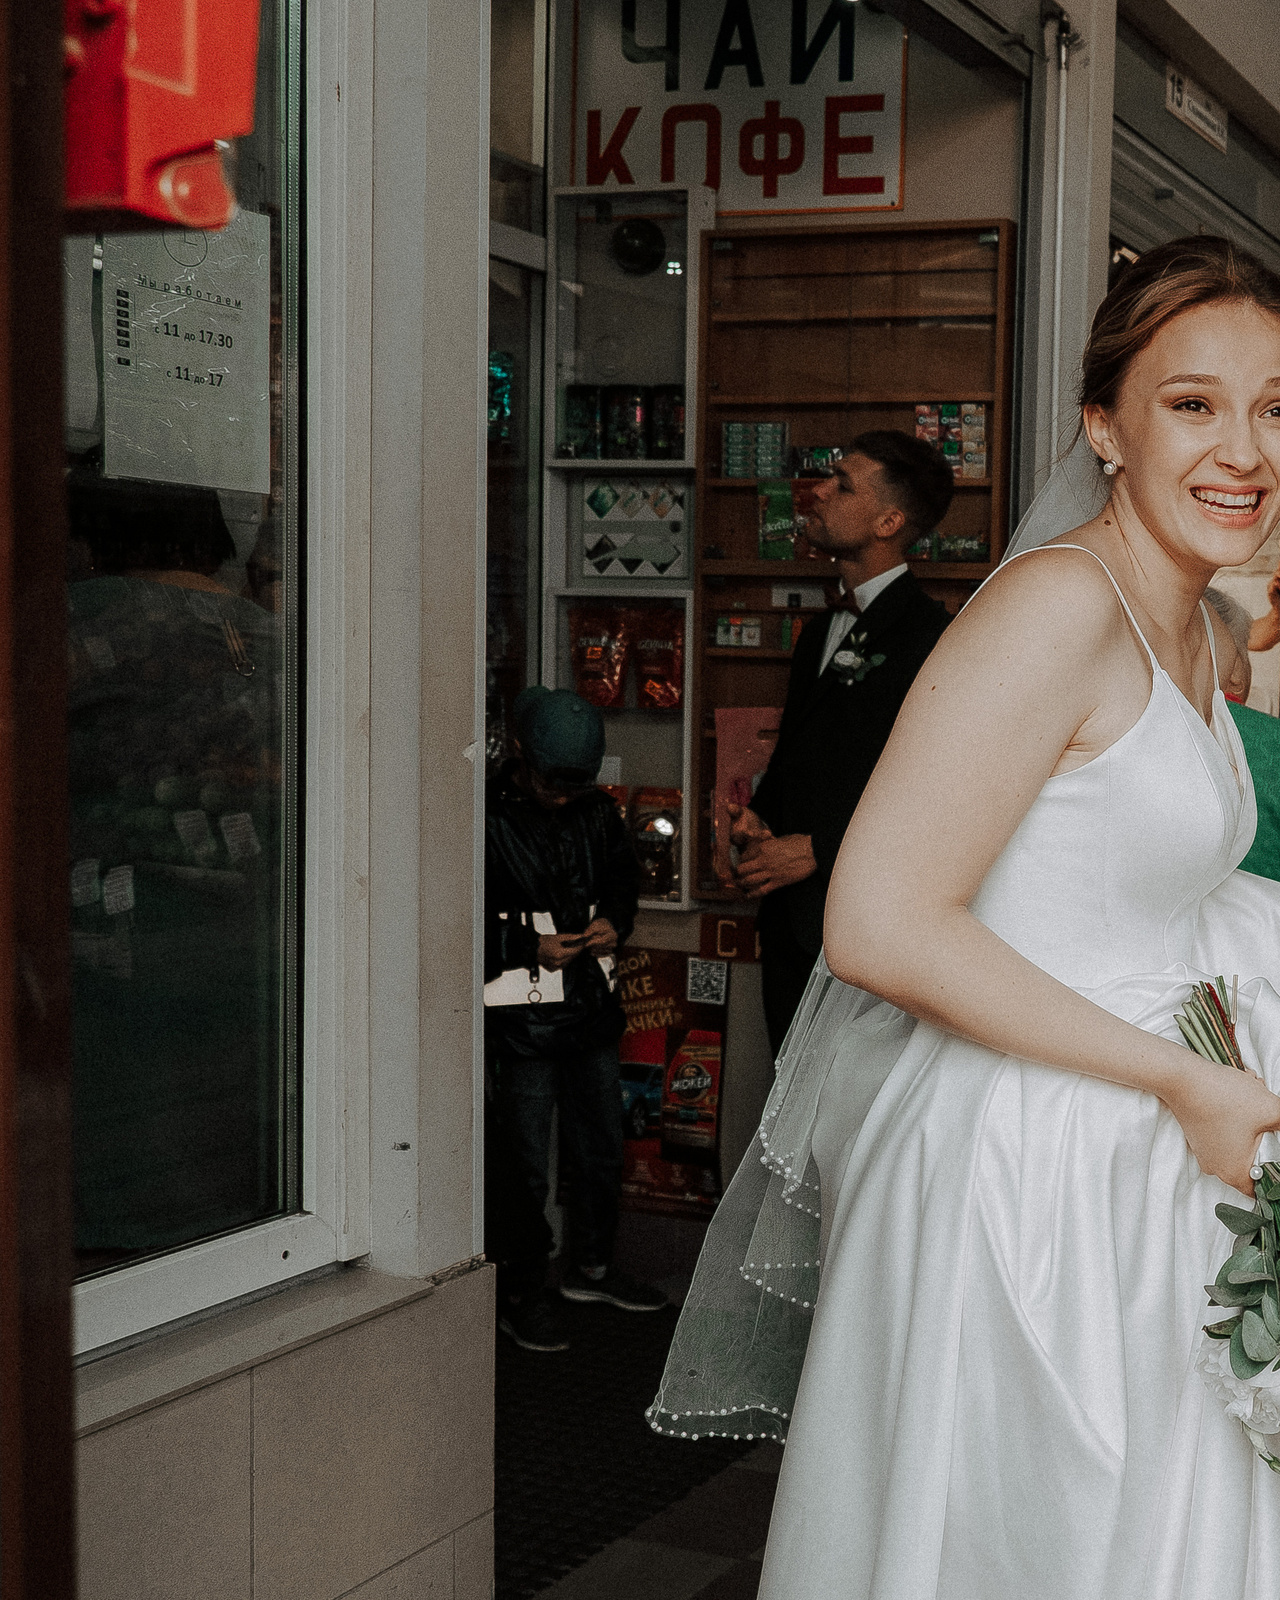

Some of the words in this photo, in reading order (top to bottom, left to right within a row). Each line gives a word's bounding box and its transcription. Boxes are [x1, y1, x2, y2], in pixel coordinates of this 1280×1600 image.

[586, 94, 885, 198] КОФЕ
[164, 281, 242, 308] работаем
[164, 322, 180, 337] 11
[184, 333, 196, 342] до
[199, 330, 233, 349] 17.30
[175, 366, 190, 381] 11
[208, 373, 224, 388] 17
[617, 951, 652, 977] ДОЙ
[624, 1008, 674, 1035] АЧКИ
